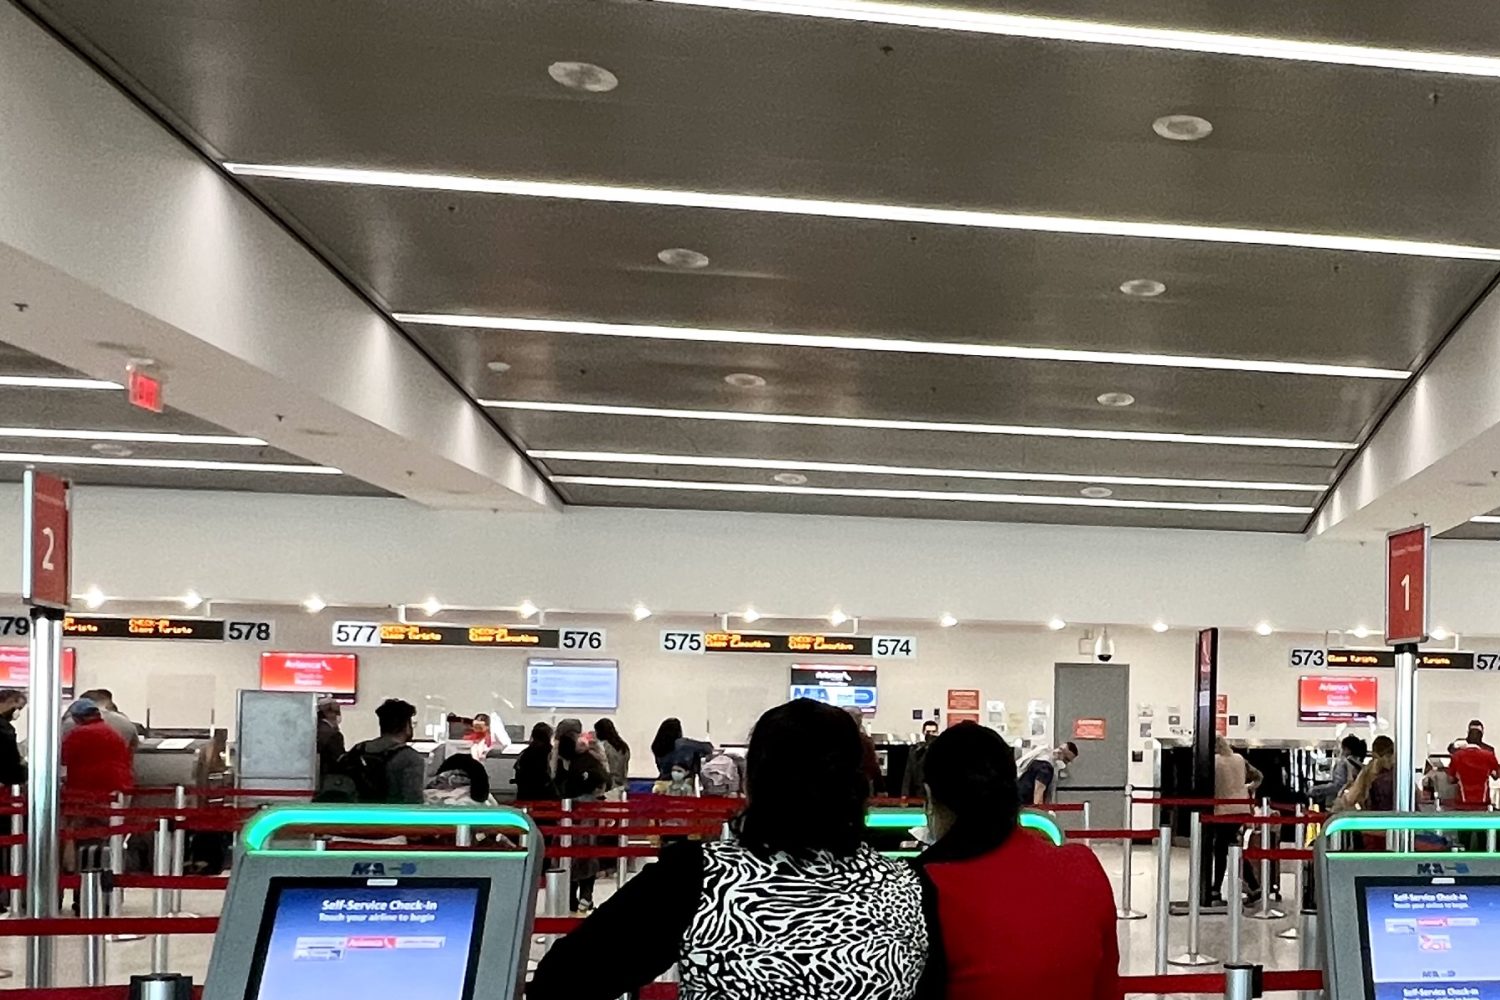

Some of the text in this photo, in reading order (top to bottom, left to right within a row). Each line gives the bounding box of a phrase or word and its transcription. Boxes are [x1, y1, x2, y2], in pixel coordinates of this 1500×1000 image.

[41, 526, 55, 571] 2
[1401, 574, 1410, 611] 1
[0, 616, 30, 636] 79
[228, 621, 271, 641] 578
[336, 624, 378, 643] 577
[562, 631, 602, 649] 576
[663, 633, 701, 651] 575
[877, 639, 912, 656] 574
[1291, 650, 1325, 666] 573
[321, 899, 387, 911] Self-Service
